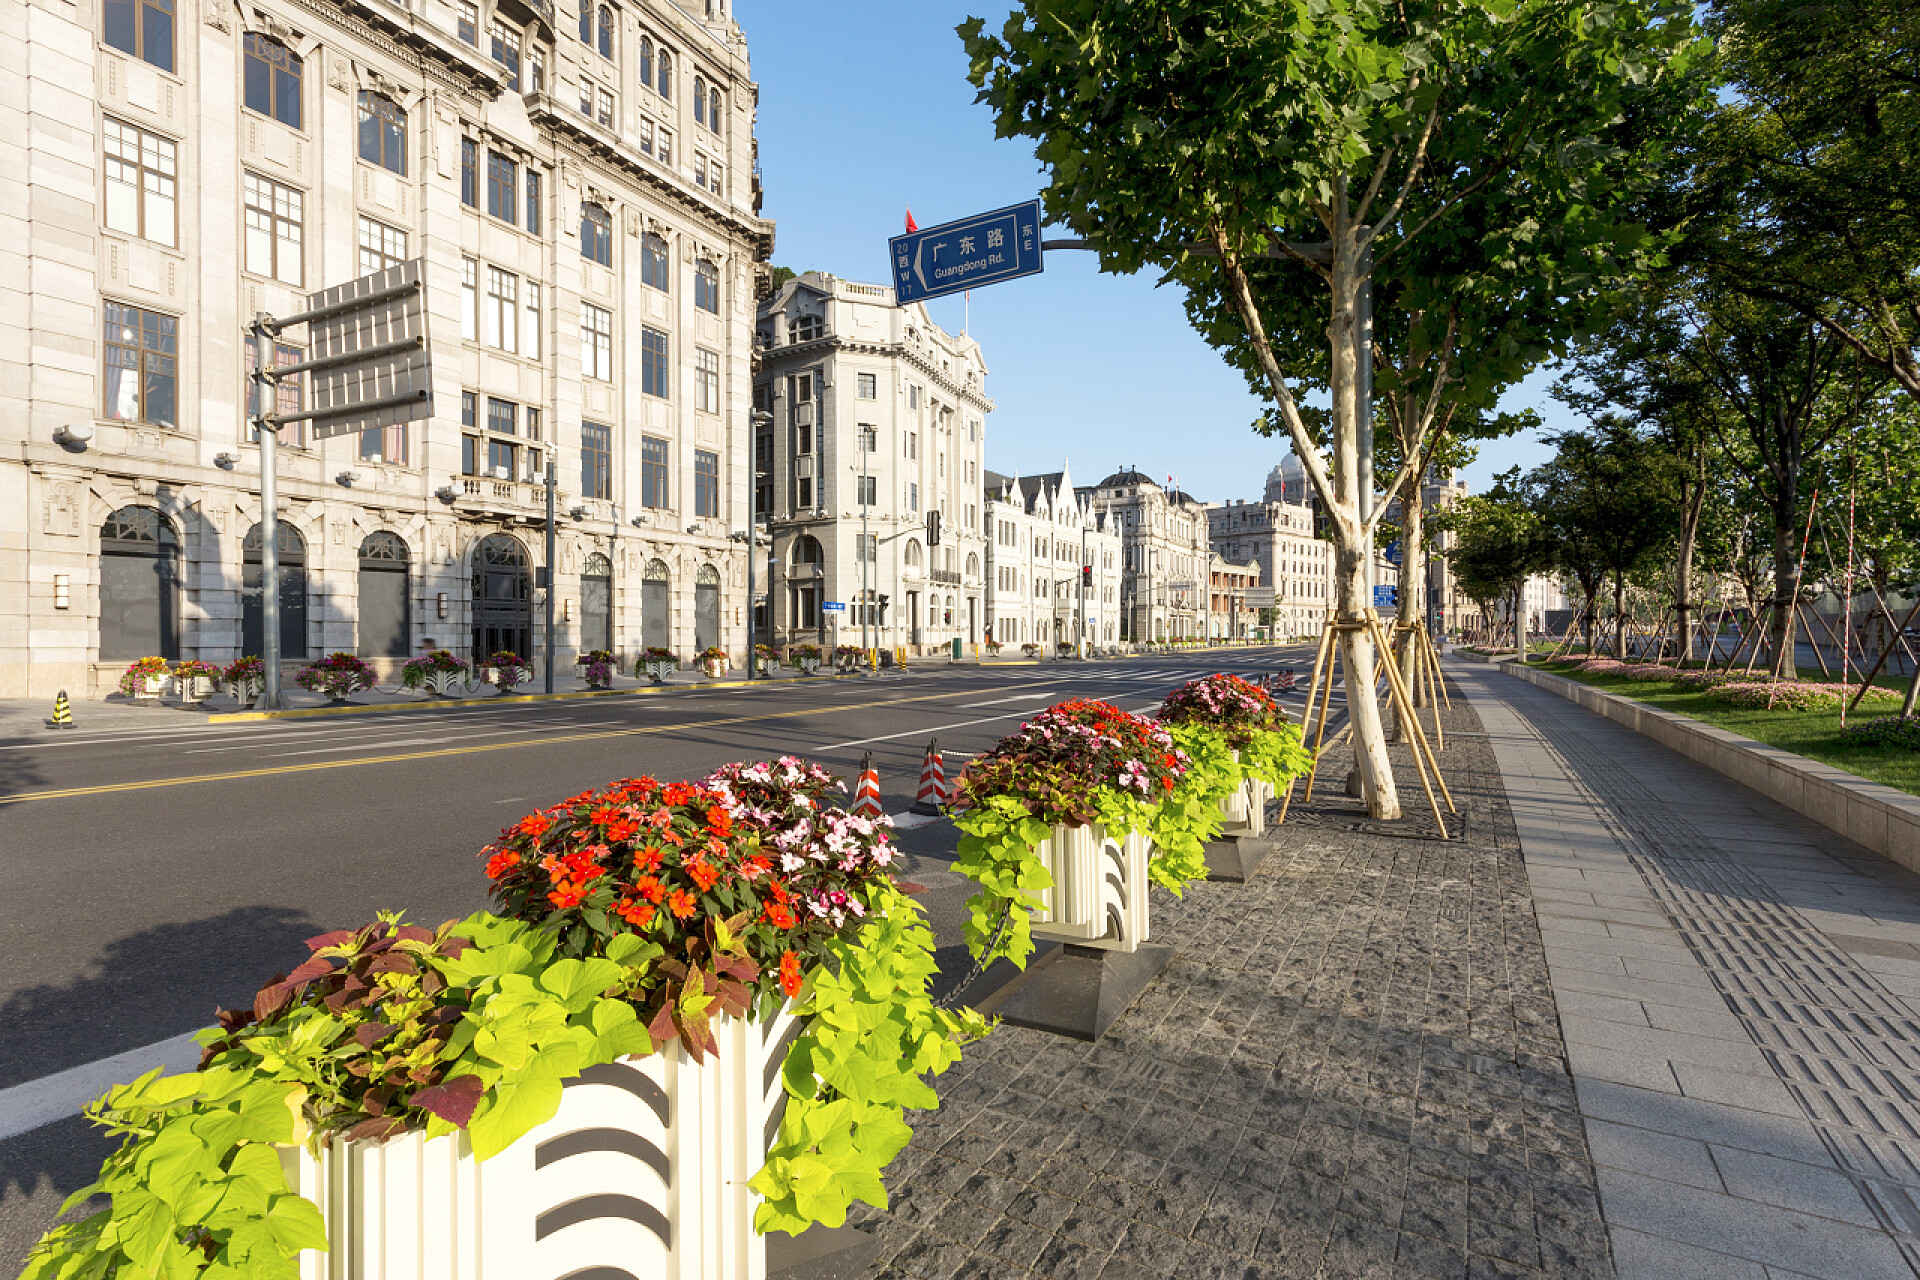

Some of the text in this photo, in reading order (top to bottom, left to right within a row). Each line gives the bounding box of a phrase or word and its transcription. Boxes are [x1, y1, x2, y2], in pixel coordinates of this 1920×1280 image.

[1022, 224, 1033, 238] 东
[897, 243, 908, 254] 20
[933, 228, 1004, 262] 广东路
[1024, 239, 1033, 251] E
[899, 255, 909, 268] 西
[934, 252, 1005, 279] Guangdong Rd.
[900, 271, 910, 282] W
